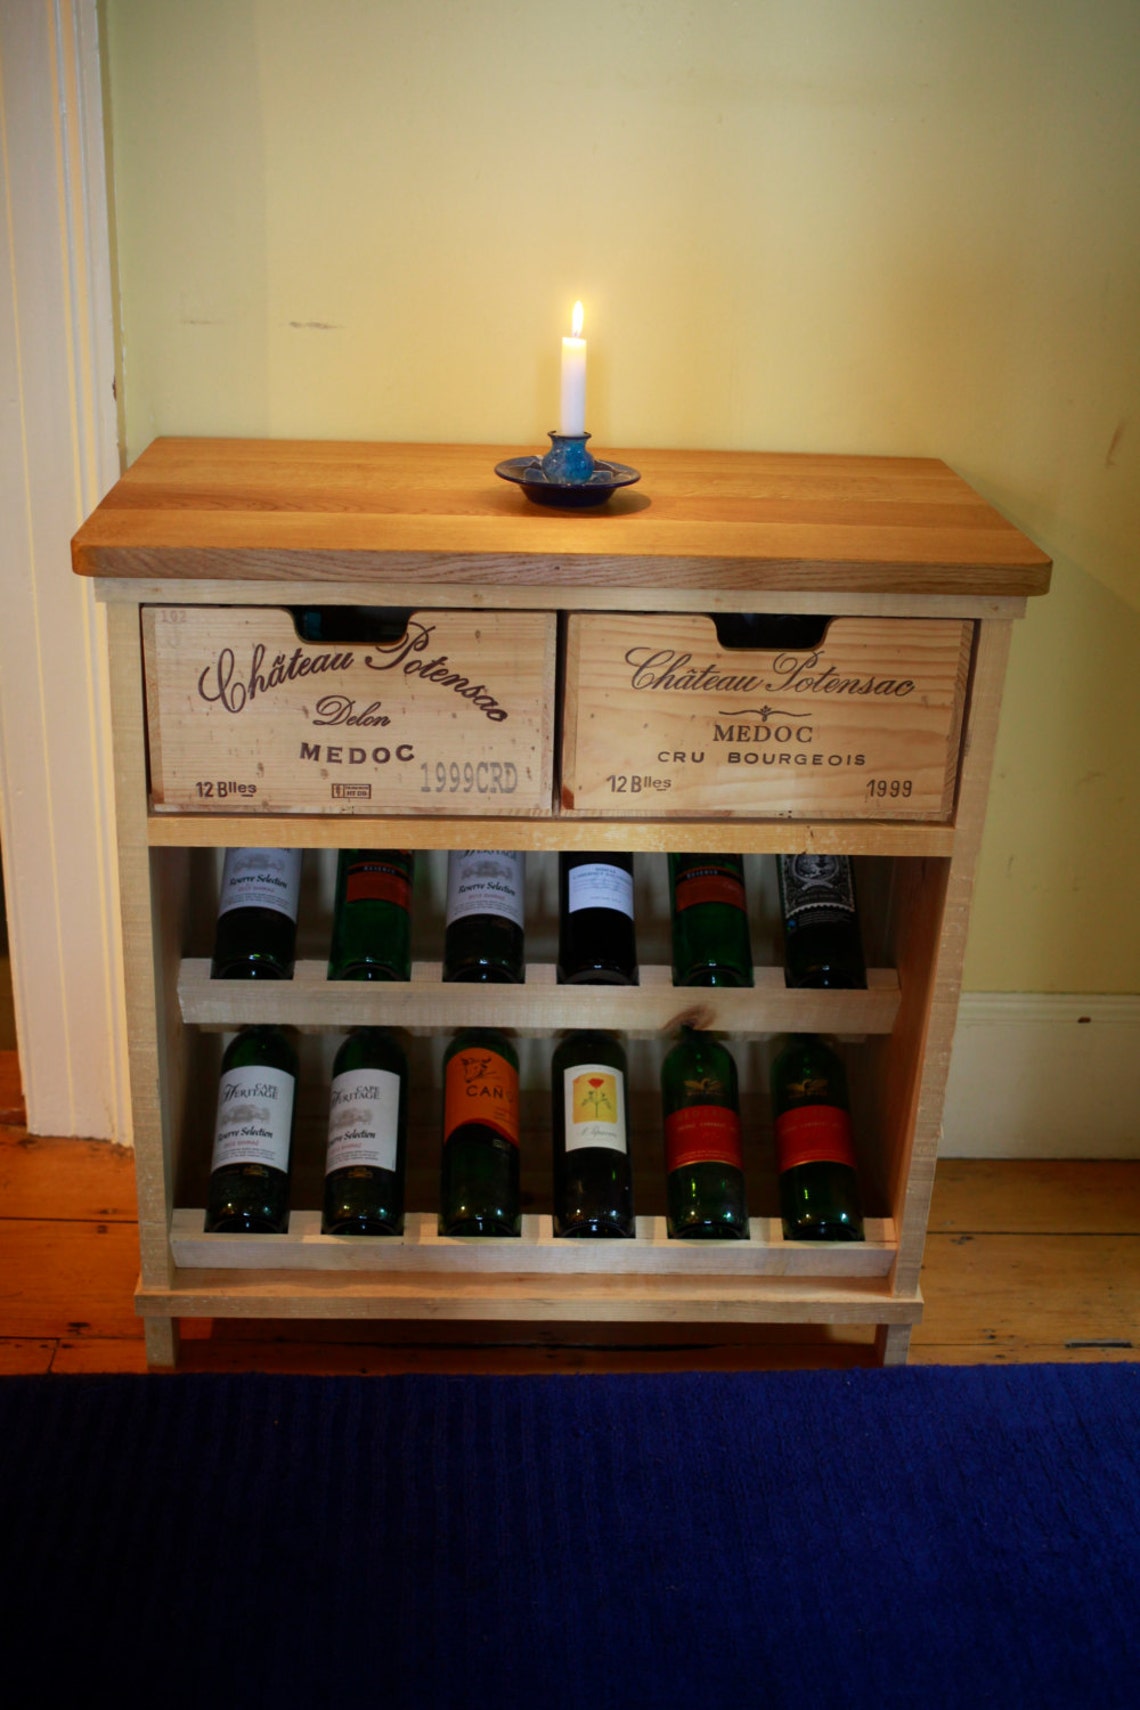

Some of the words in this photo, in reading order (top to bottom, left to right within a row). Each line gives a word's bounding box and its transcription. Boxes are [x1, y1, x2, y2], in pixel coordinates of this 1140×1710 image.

[197, 643, 355, 714] Château
[364, 620, 509, 723] Potensac
[624, 647, 761, 692] Château
[765, 650, 916, 698] Potensac
[312, 695, 391, 727] Delon
[712, 724, 814, 744] MEDOC
[300, 742, 416, 765] MEDOC
[657, 751, 706, 764] CRU
[728, 752, 867, 767] BOURGEOIS
[419, 761, 519, 794] 1999CRD
[865, 779, 913, 799] 1999
